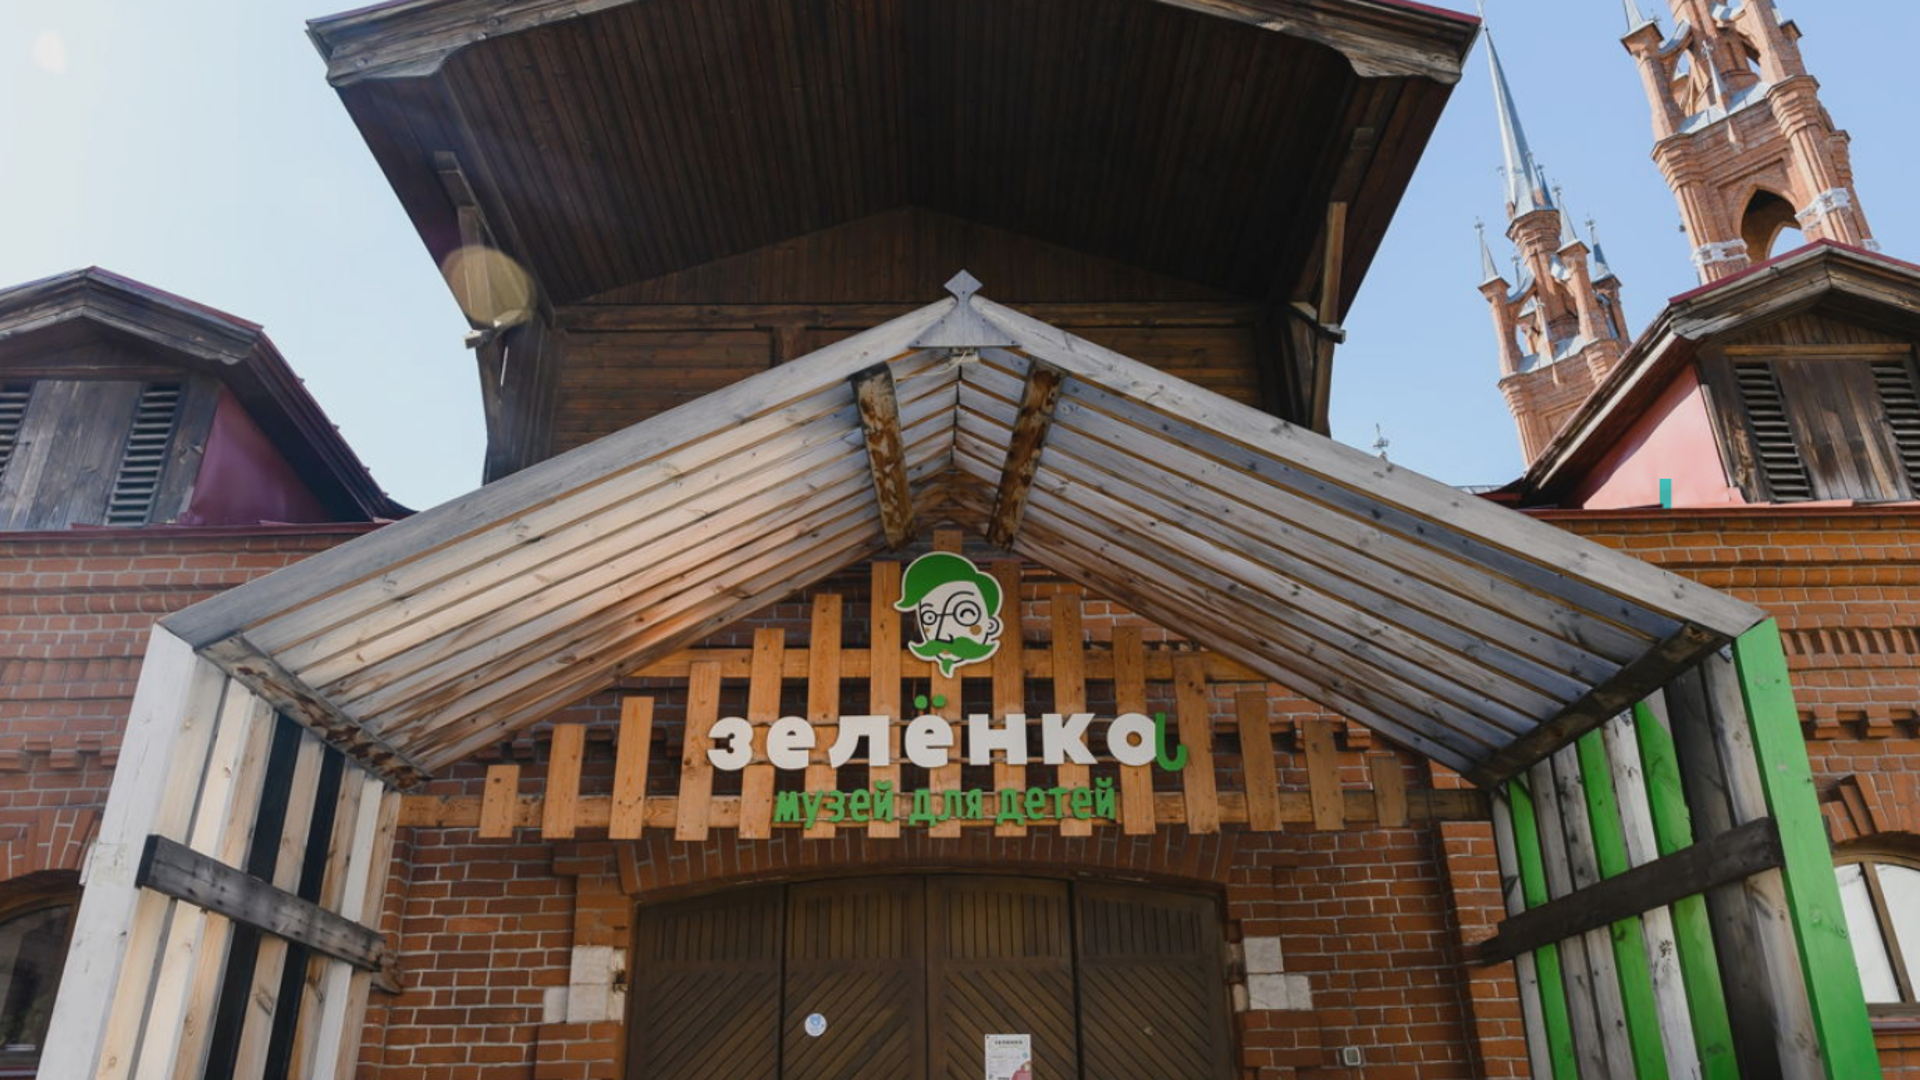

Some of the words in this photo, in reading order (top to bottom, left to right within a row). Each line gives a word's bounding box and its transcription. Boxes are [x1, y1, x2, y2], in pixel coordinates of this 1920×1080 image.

[774, 780, 894, 828] музей
[909, 786, 983, 825] для
[996, 777, 1116, 824] детей
